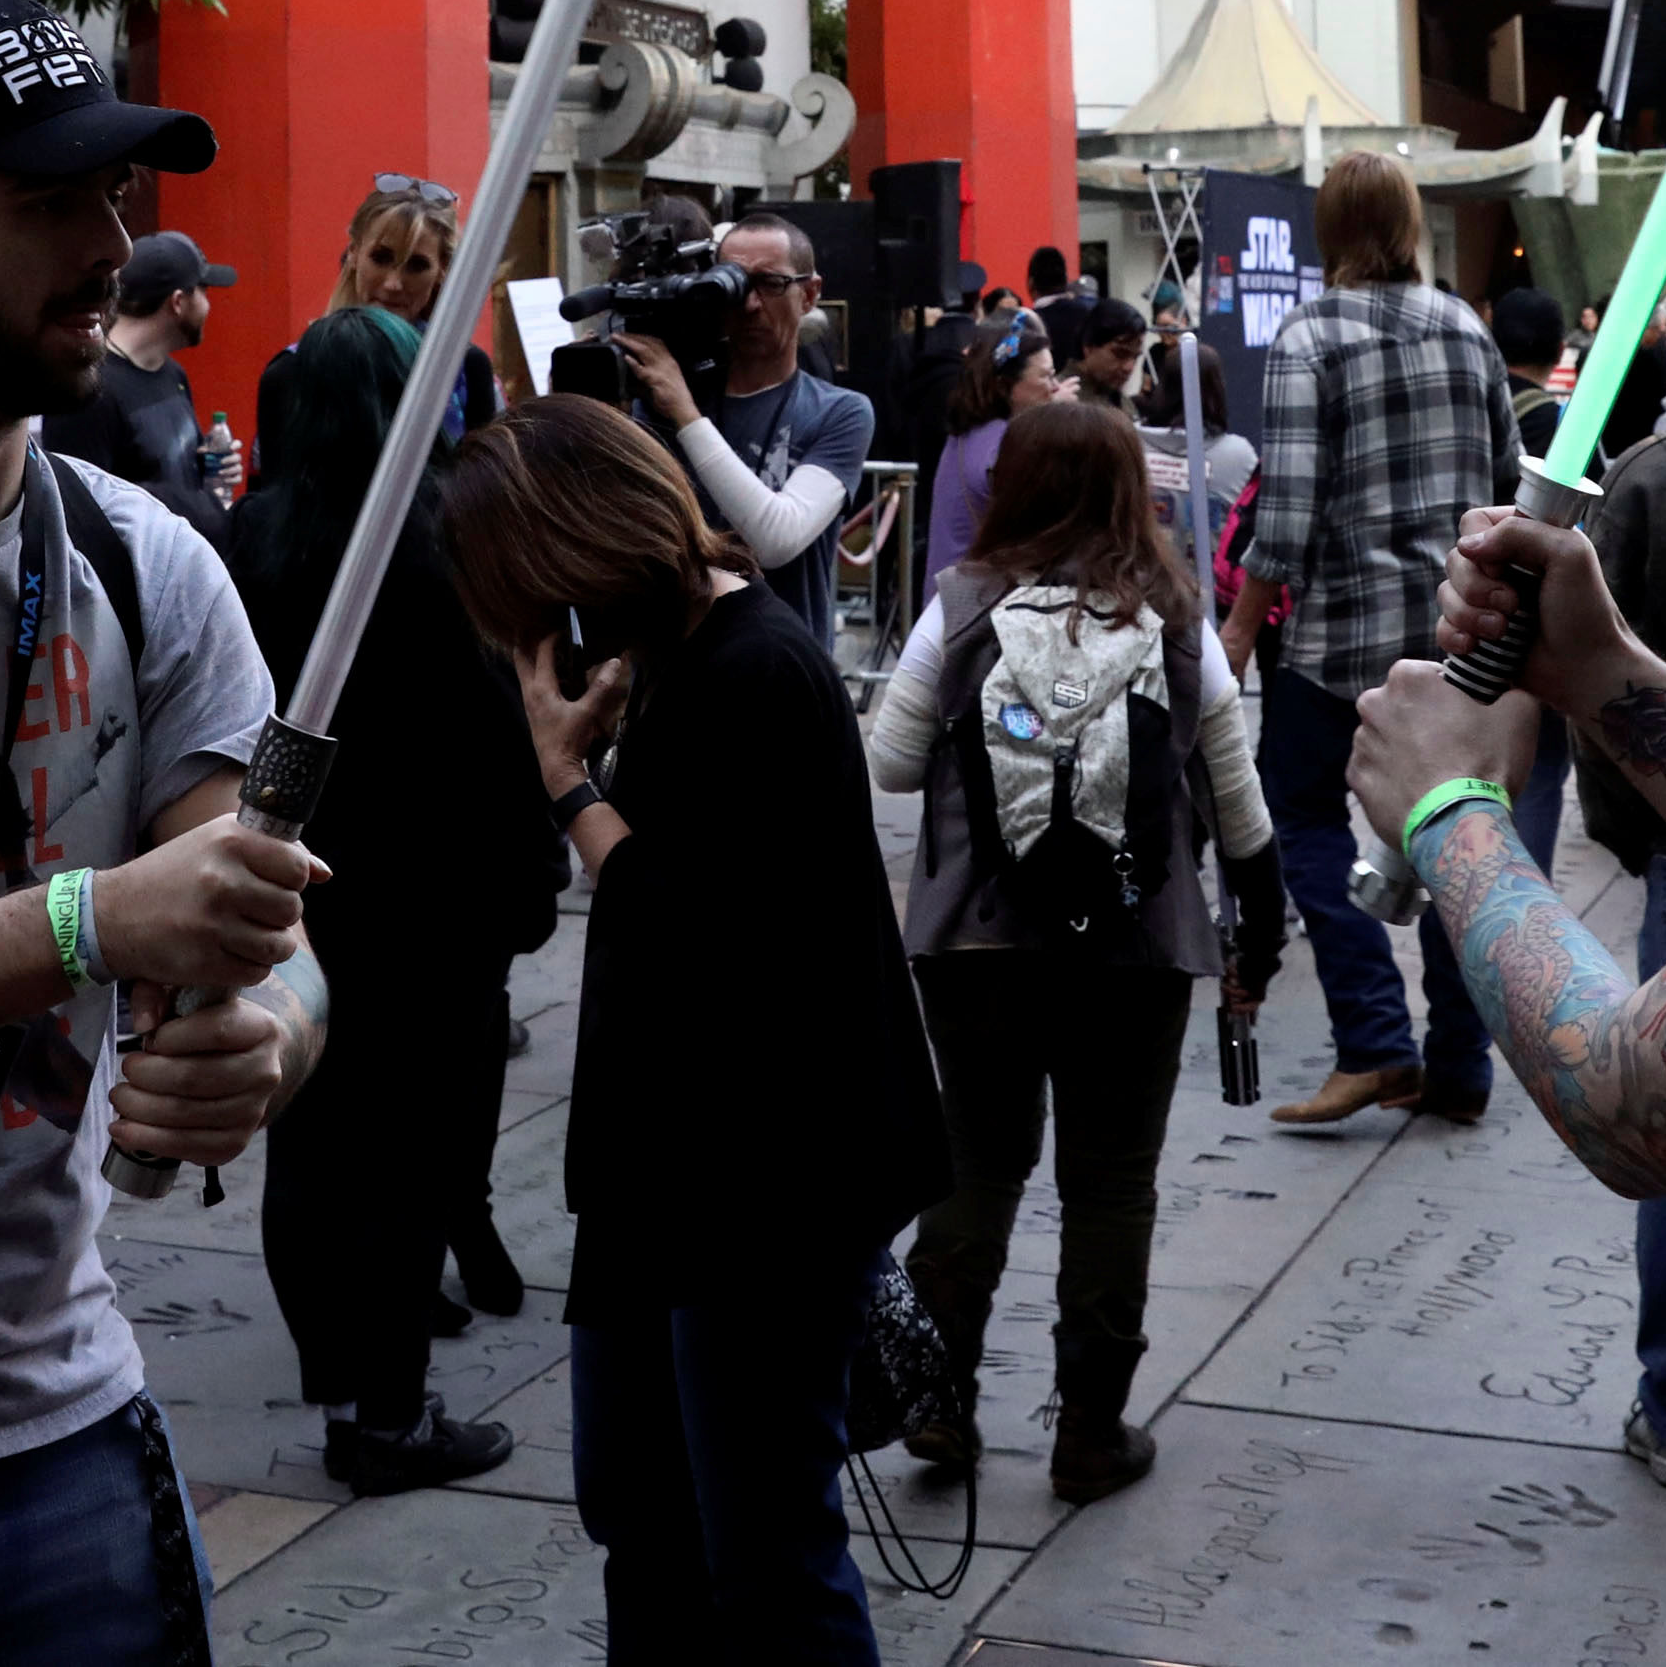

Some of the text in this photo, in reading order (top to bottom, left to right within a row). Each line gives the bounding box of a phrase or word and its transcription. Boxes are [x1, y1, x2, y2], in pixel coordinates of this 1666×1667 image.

[1, 53, 104, 105] FET
[1241, 216, 1295, 272] STAR
[17, 570, 43, 656] IMAX
[1281, 1364, 1337, 1388] To
